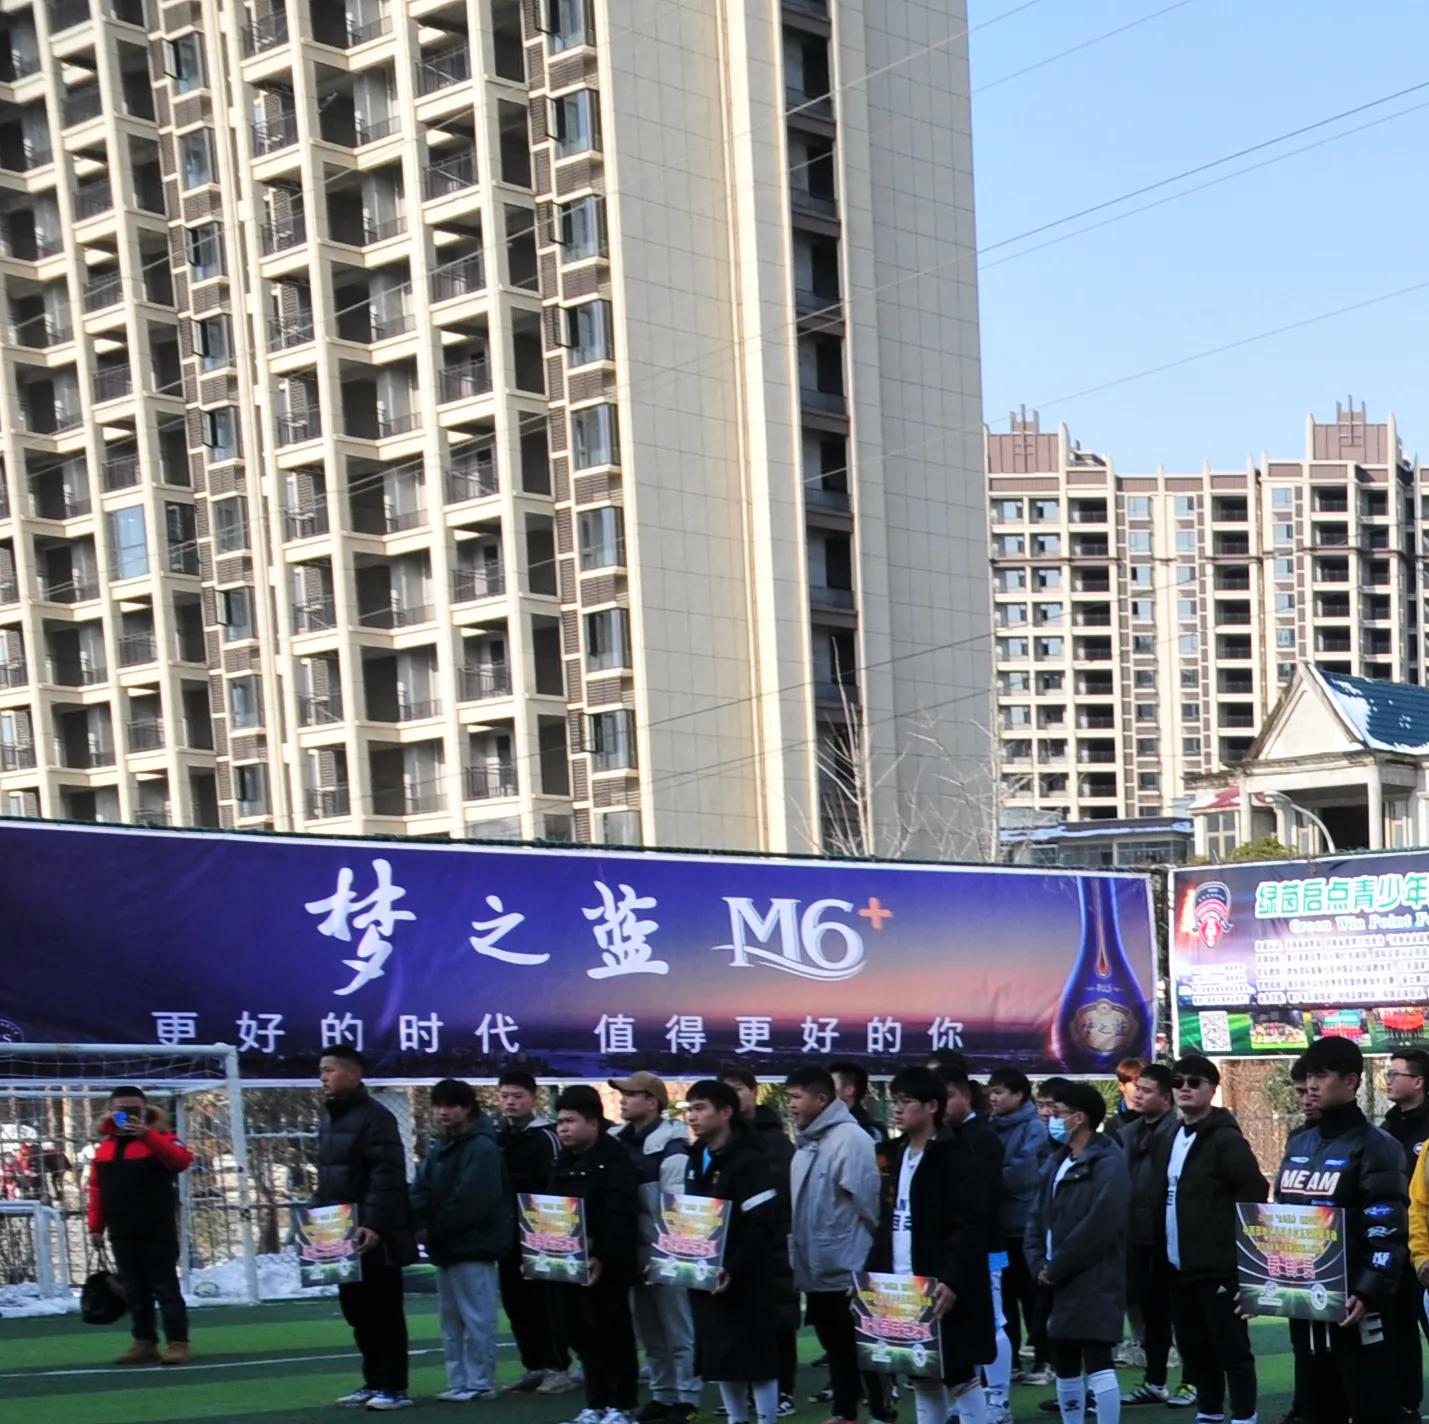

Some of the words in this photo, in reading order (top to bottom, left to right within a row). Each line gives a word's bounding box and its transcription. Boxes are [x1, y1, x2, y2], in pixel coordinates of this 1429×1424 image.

[304, 858, 670, 996] 梦之蓝
[151, 1011, 522, 1054] 更好的时代
[593, 1013, 965, 1055] 值得更好的你
